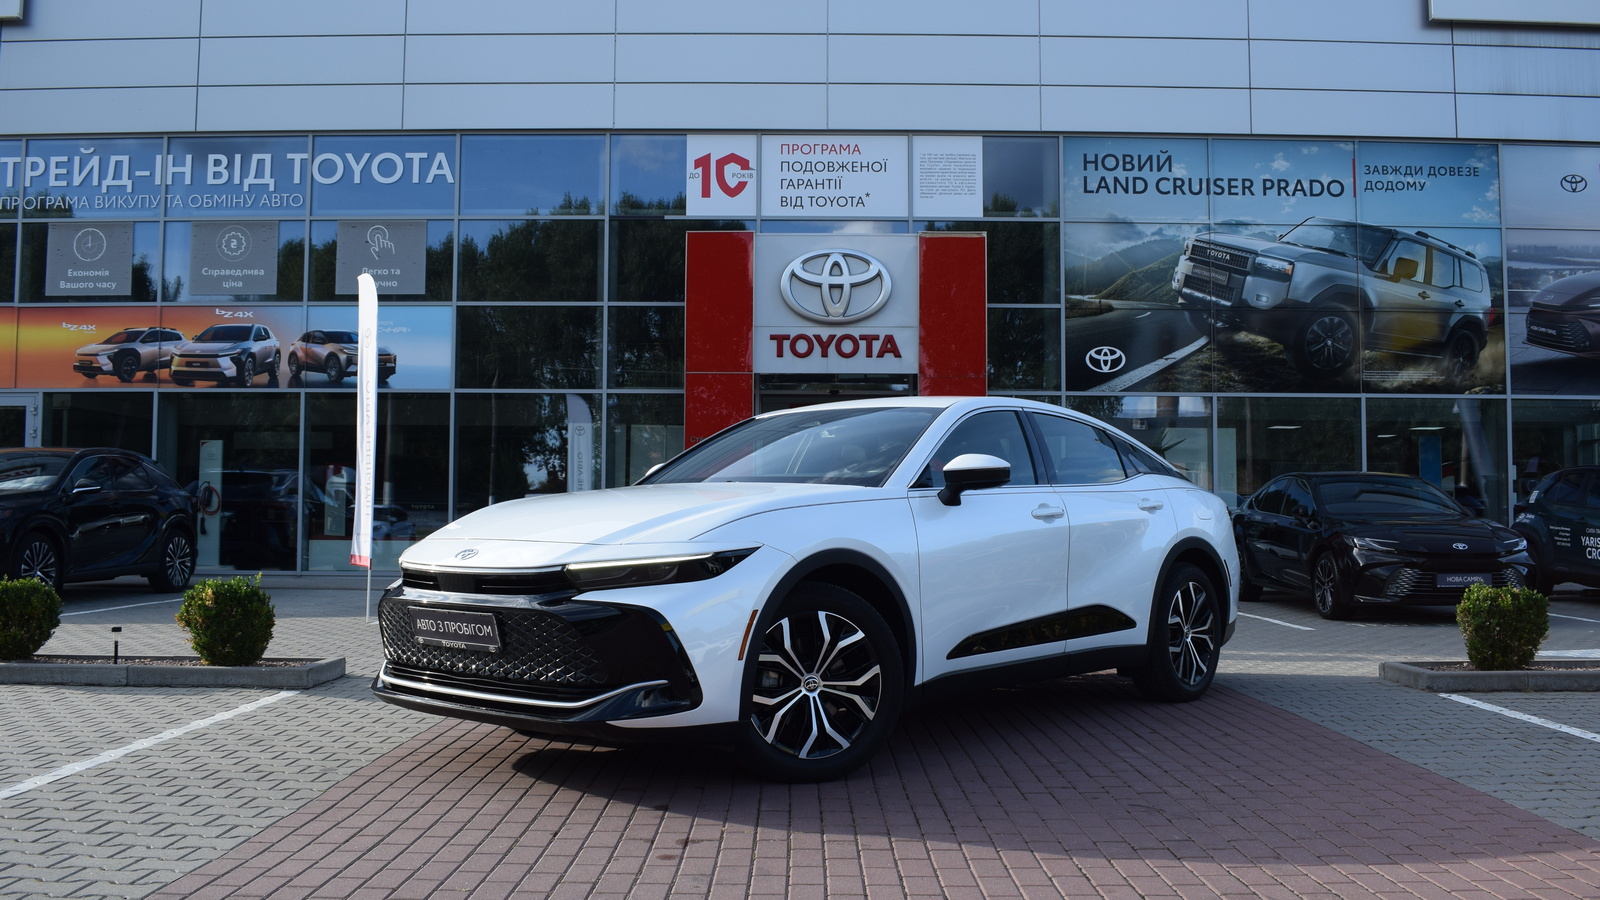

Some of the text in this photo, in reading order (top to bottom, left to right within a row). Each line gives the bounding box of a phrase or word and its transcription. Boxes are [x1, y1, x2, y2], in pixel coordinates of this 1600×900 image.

[781, 144, 862, 154] ПРОГРАМА
[781, 158, 888, 174] ПОДОВЖЕНОЇ
[1083, 150, 1172, 172] НОВИЙ
[0, 147, 455, 193] ТРЕЙД-ІН ВІД TOYOTA
[1364, 164, 1480, 178] ЗАВЖДИ ДОВЕЗЕ
[781, 176, 842, 190] ГАРАНТІЇ
[1083, 176, 1345, 198] LAND CRUISER PRADO
[1364, 180, 1426, 192] ДОДОМУ
[0, 193, 304, 210] ПРОГРАМА ВИКУПУ ТА ОБМІНУ АВТО
[780, 196, 804, 210] ВІД
[1206, 250, 1230, 260] TOYOTA
[68, 268, 110, 277] Економія
[202, 268, 264, 277] Справедлива
[60, 280, 116, 290] Вашого часу
[222, 279, 243, 289] ціна
[770, 334, 902, 359] TOYOTA
[1580, 536, 1600, 548] YARIS
[416, 618, 436, 632] АВТО
[444, 621, 493, 636] ПРОБІГОМ
[442, 640, 467, 649] TOYOTA
